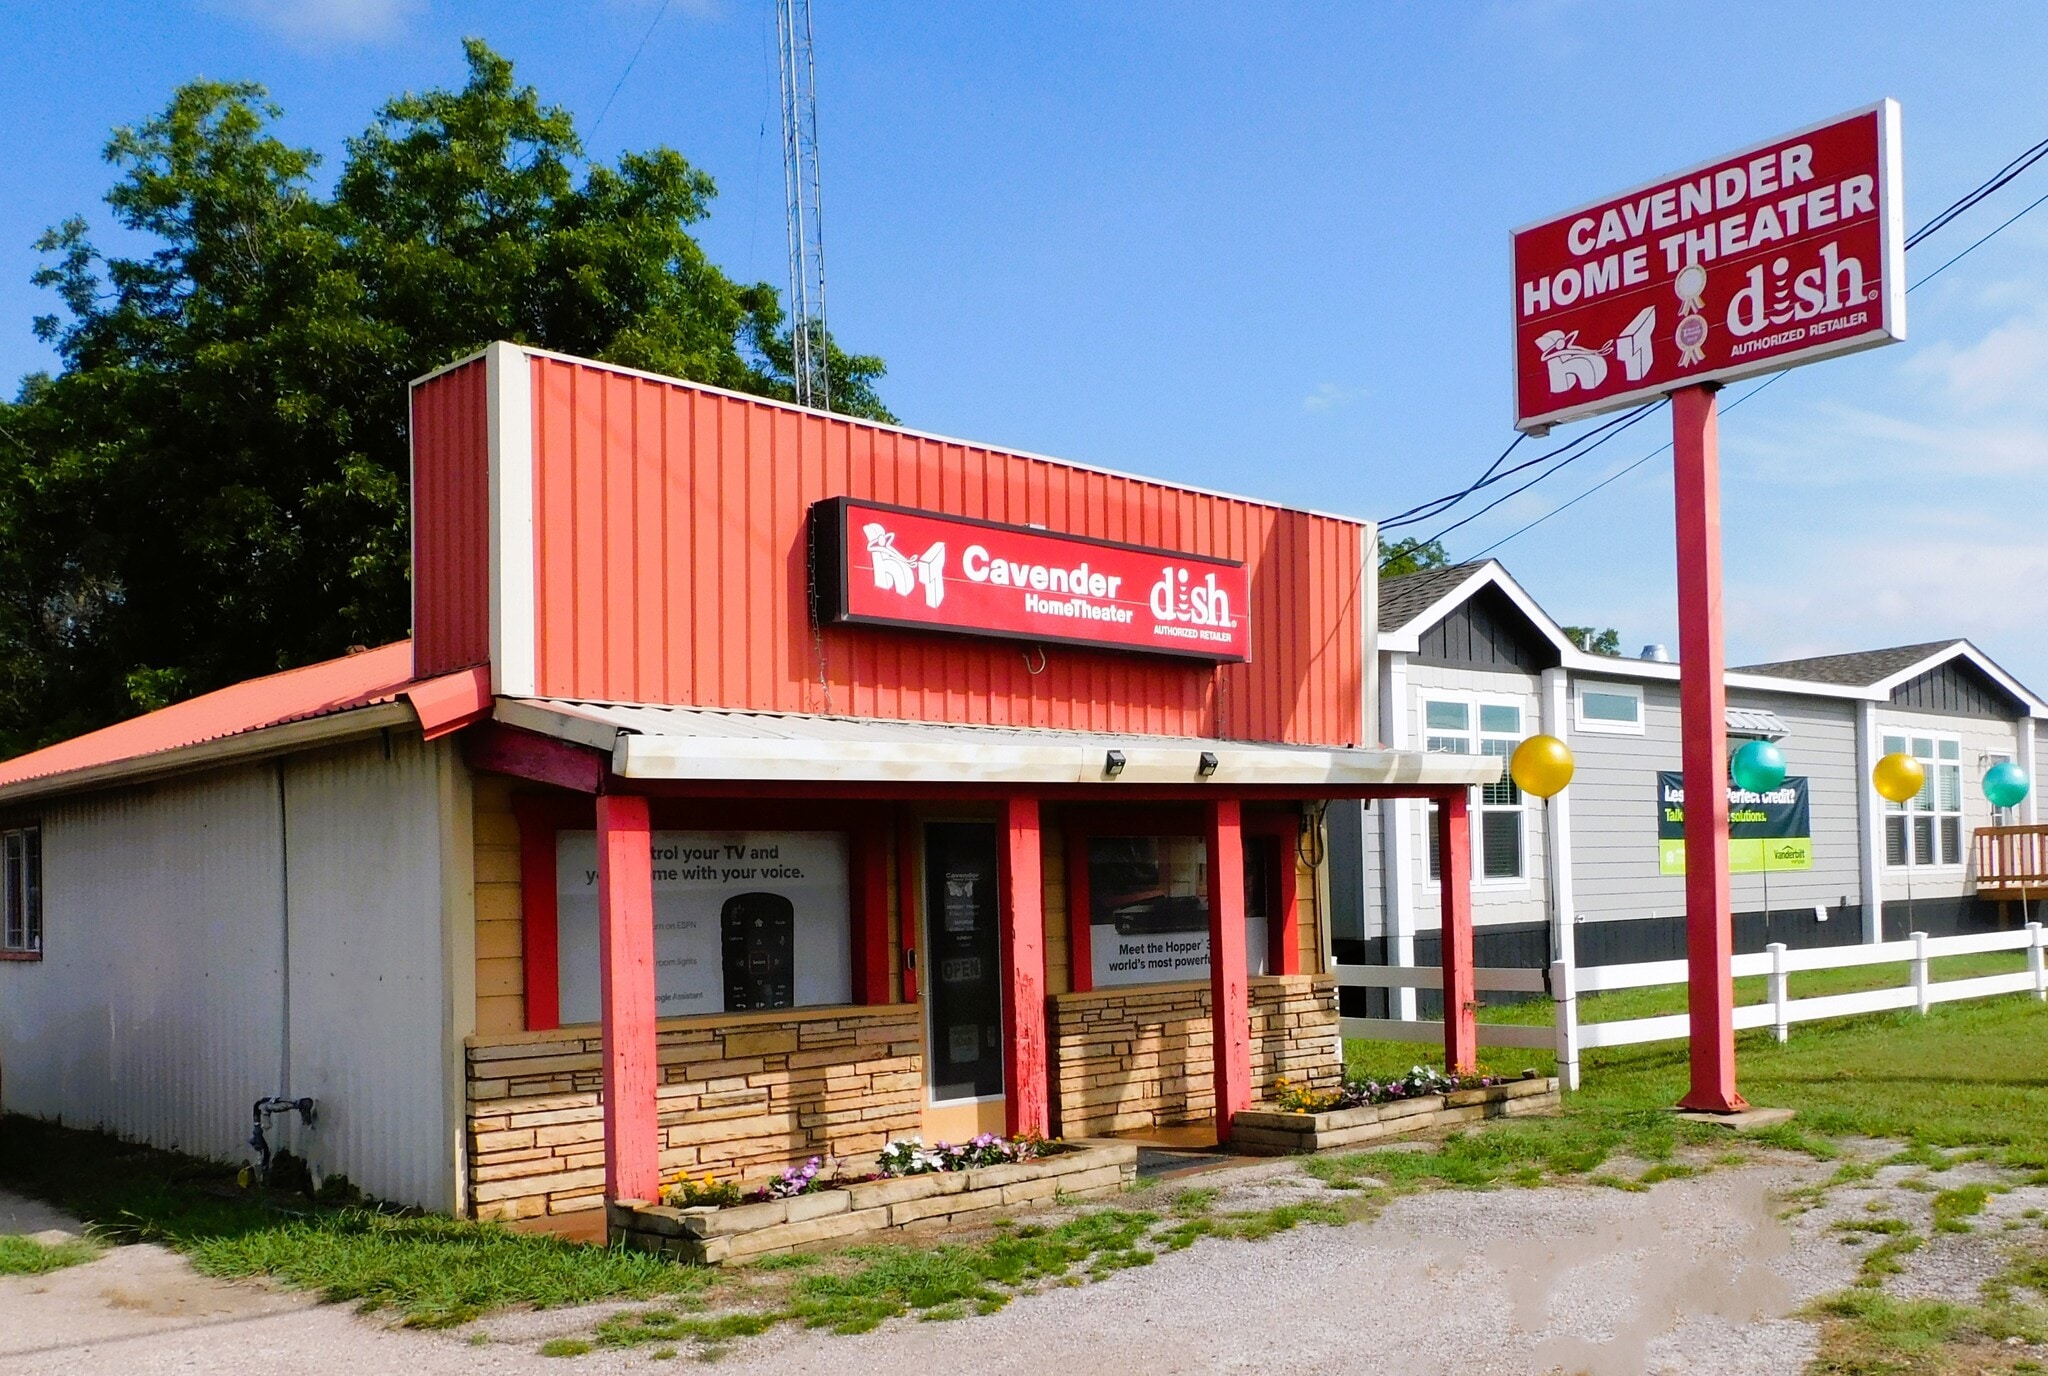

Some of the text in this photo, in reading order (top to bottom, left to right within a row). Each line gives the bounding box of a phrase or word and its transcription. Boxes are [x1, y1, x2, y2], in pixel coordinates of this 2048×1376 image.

[1567, 143, 1814, 256] CAVENDER
[1523, 174, 1876, 317] HOME THEATER
[1727, 241, 1868, 337] dish
[1731, 328, 1805, 357] AUTHORIZED
[1809, 311, 1868, 336] RETAILER
[962, 545, 1122, 599] Cavender
[1150, 566, 1232, 627] dish
[1024, 592, 1133, 624] HomeTheater
[1153, 625, 1232, 642] AUTHORIZED RETAILER
[651, 845, 779, 863] trol your TV and
[683, 865, 717, 880] with
[722, 868, 756, 883] your
[761, 865, 805, 880] voice.
[677, 920, 697, 930] ESPN
[1119, 943, 1144, 955] Meet
[1147, 942, 1163, 953] the
[1166, 940, 1201, 955] Hopper
[945, 958, 981, 979] OPEN
[1109, 958, 1146, 972] world's
[1148, 957, 1172, 968] most
[672, 990, 704, 1001] Assistant
